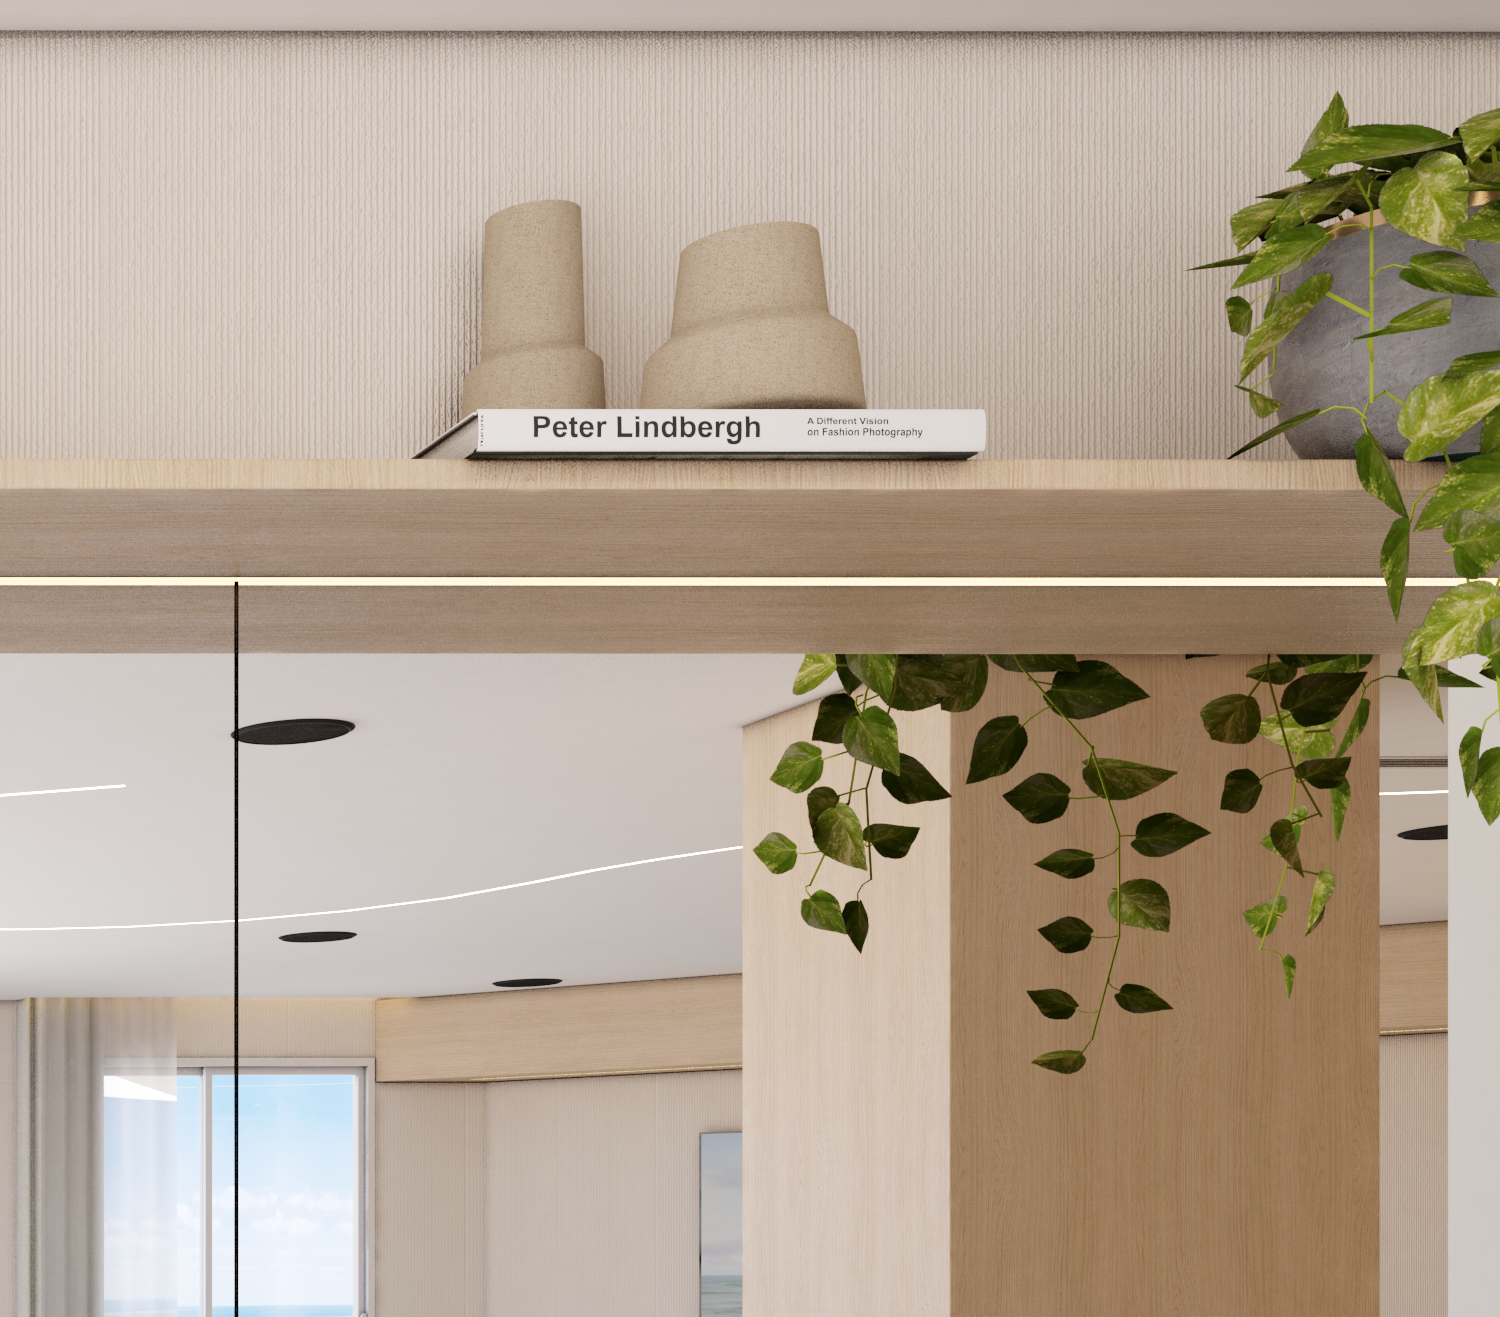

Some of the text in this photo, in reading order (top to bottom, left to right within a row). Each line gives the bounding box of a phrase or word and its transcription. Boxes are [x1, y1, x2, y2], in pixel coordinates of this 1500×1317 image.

[807, 417, 889, 425] A Different Vision
[533, 416, 761, 444] Peter Lindbergh
[807, 427, 924, 438] on Fashion Photography
